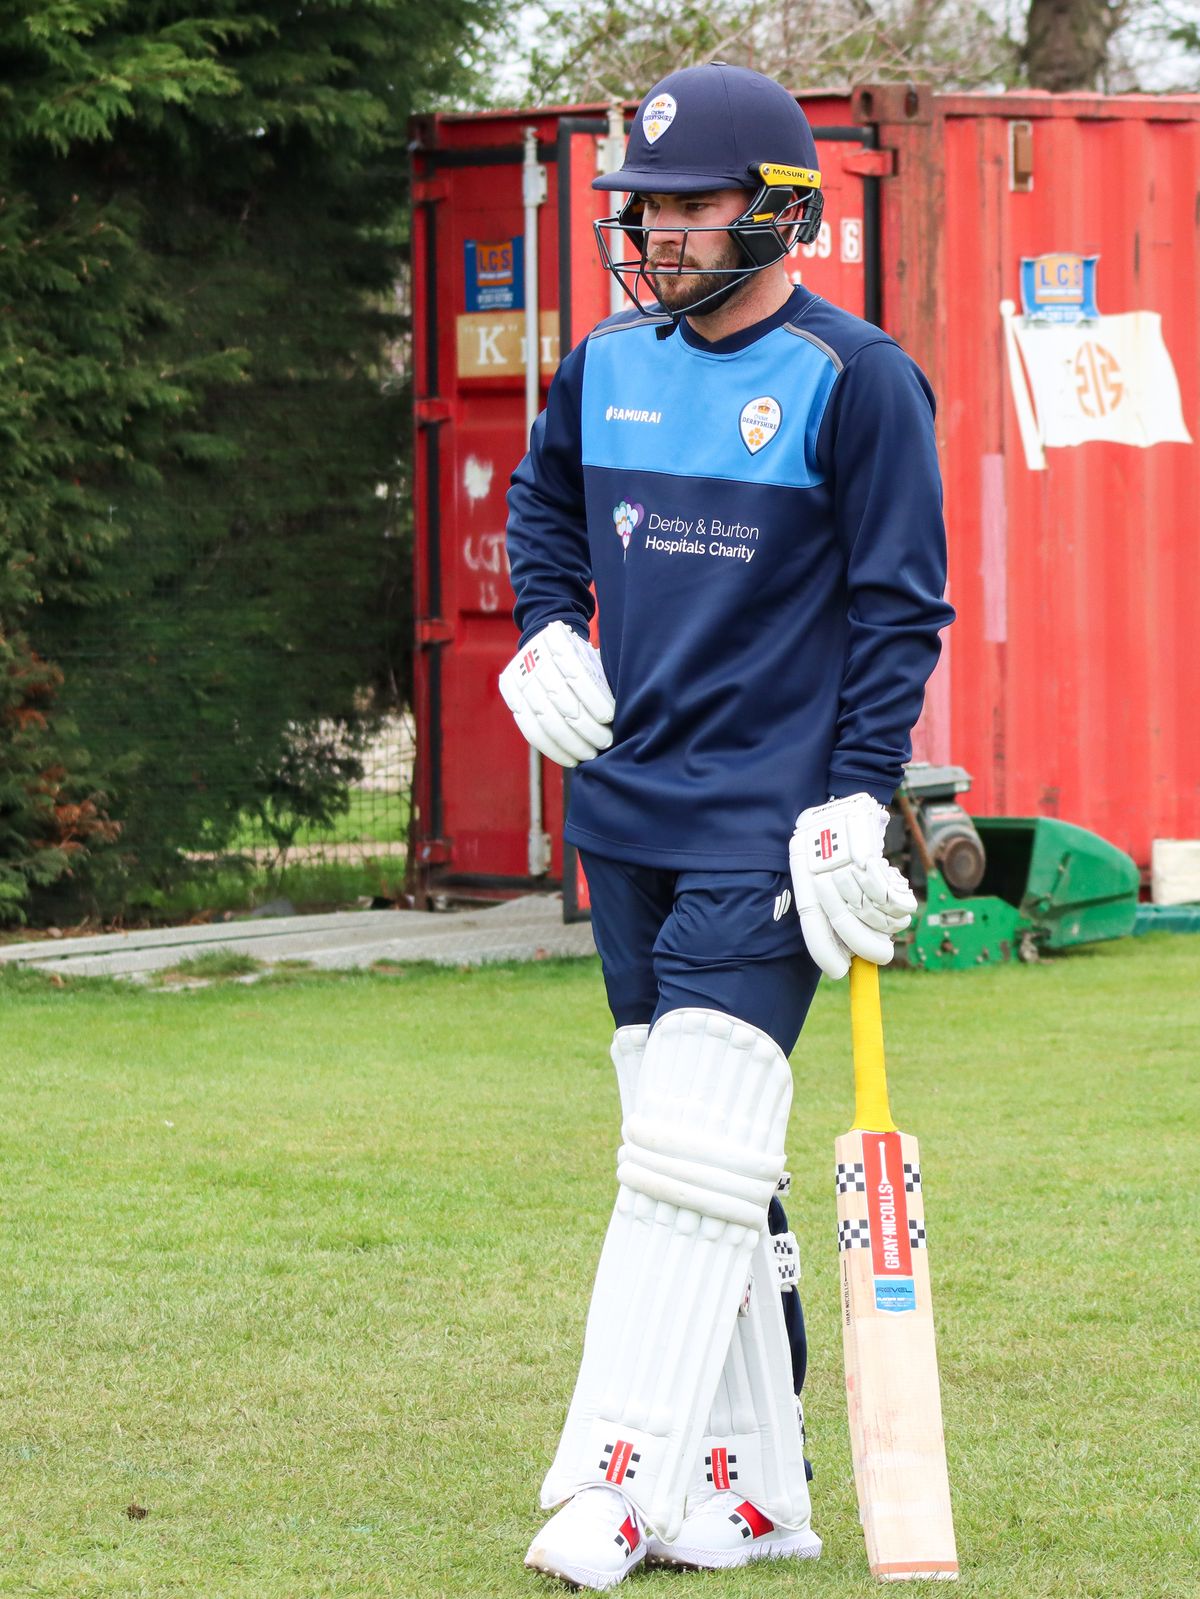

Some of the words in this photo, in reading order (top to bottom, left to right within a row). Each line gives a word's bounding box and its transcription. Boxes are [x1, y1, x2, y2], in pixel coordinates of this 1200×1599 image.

[772, 168, 806, 179] MASURI
[843, 221, 861, 260] 6
[613, 408, 661, 424] SAMURAI
[742, 416, 777, 430] DERBYSHIRE
[648, 513, 693, 537] Derby
[696, 518, 707, 535] &
[710, 519, 760, 540] Burton
[645, 535, 706, 555] Hospitals
[708, 541, 756, 563] Charity
[878, 1184, 900, 1269] GRAY-NICOLLS
